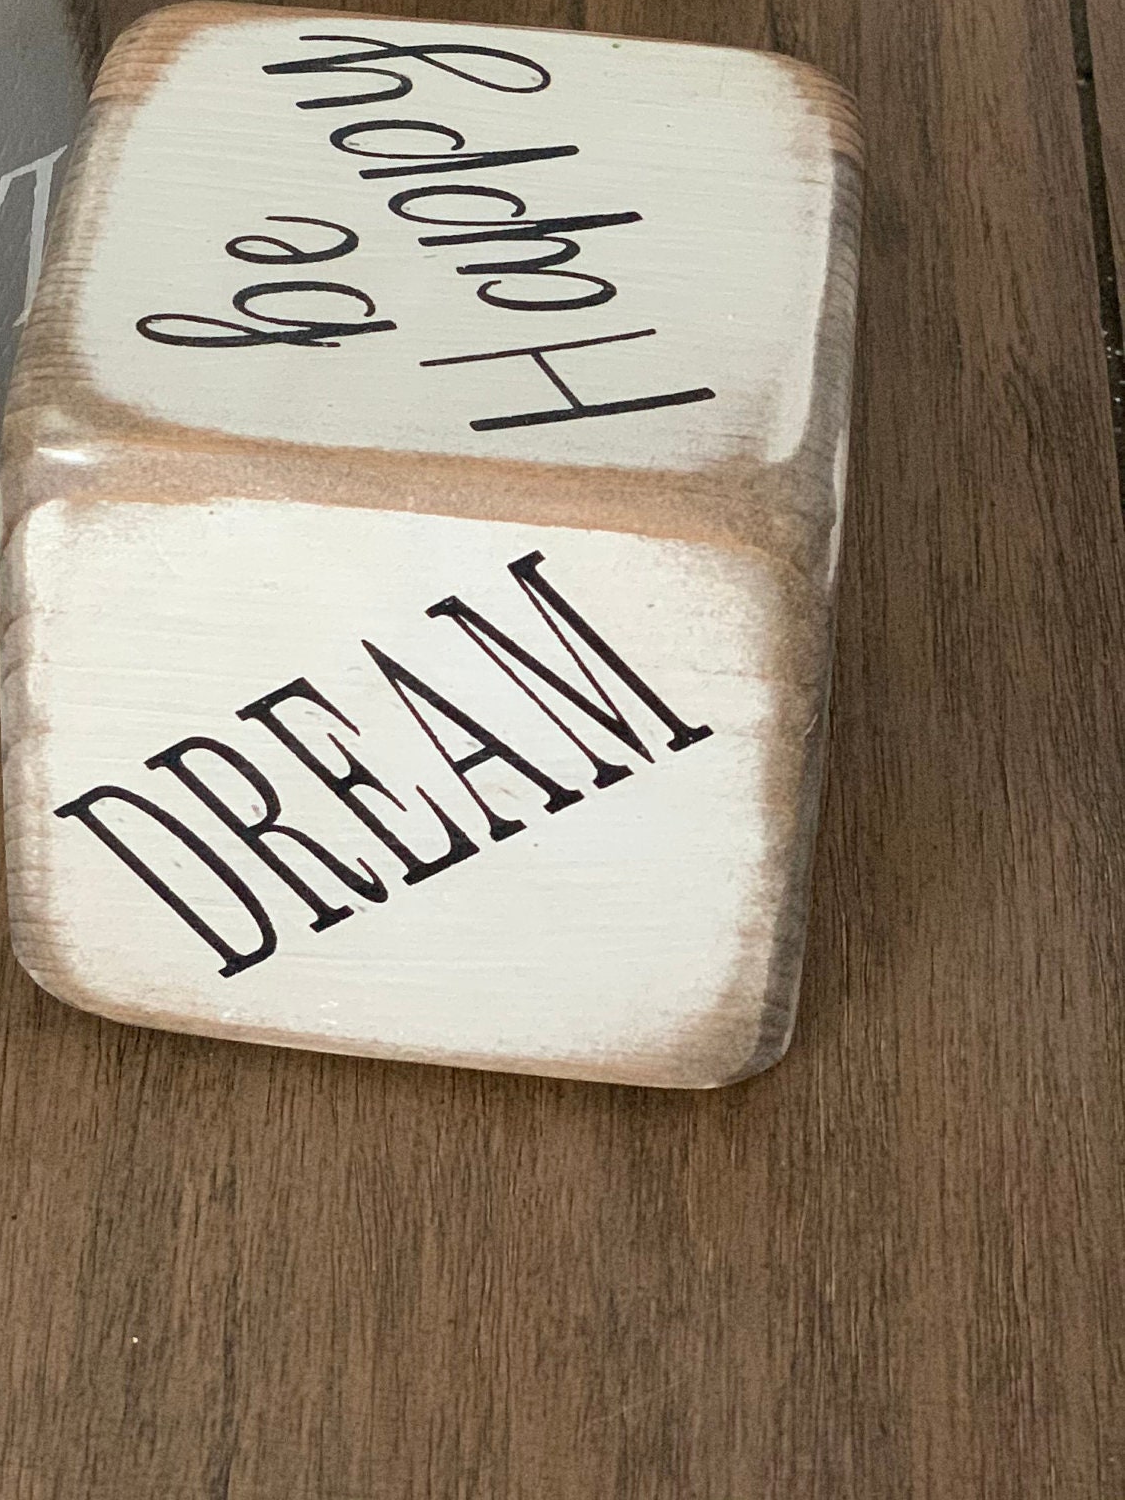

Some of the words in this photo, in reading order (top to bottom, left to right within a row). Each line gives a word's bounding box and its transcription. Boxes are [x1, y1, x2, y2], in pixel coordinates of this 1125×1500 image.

[135, 215, 397, 349] be
[261, 34, 716, 432] Happy
[53, 550, 714, 979] DREAM
